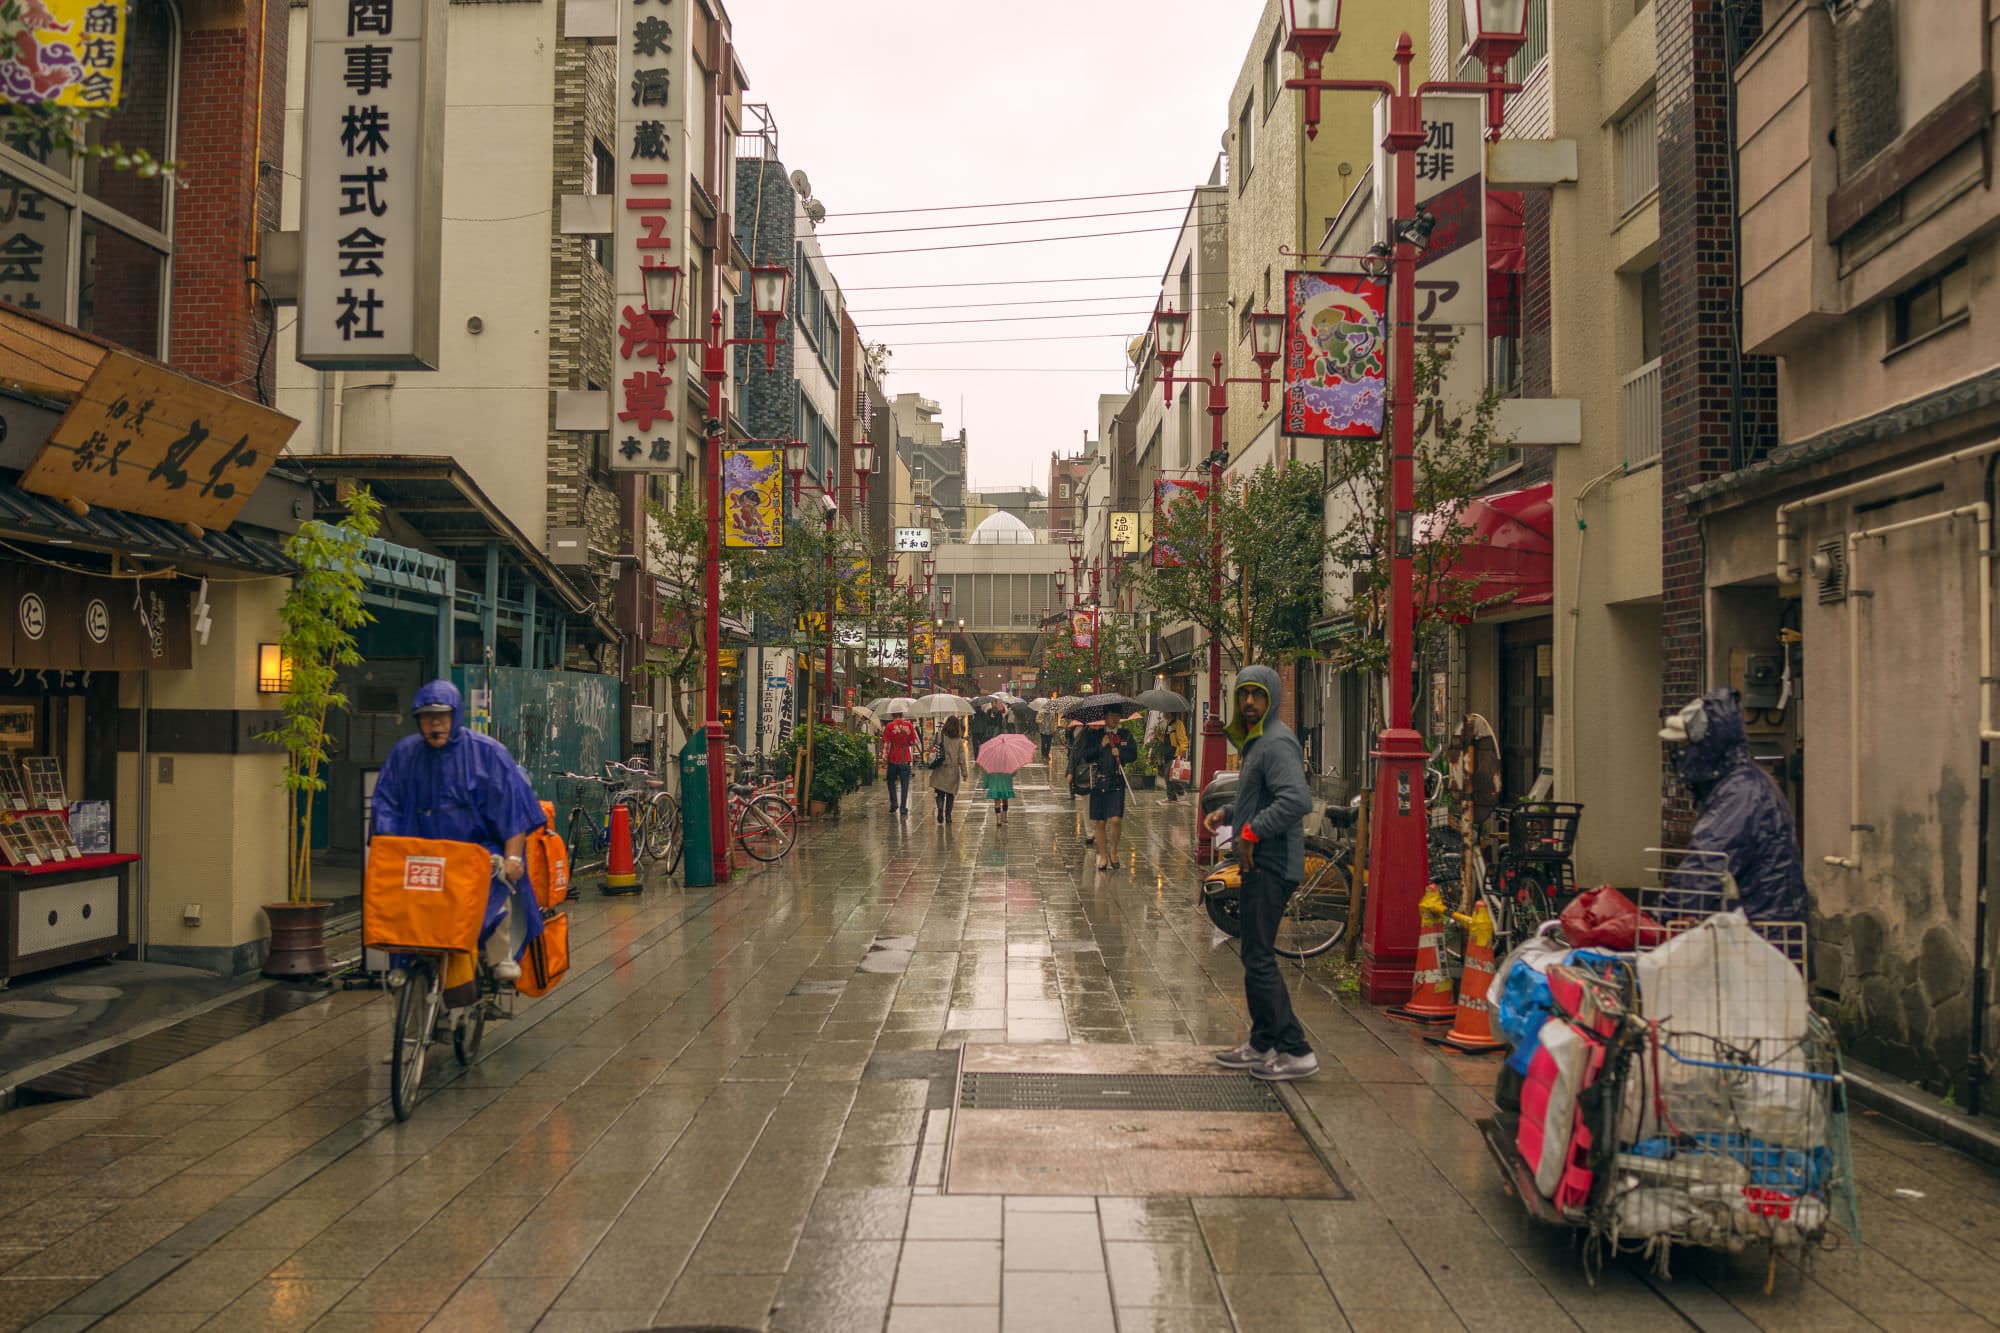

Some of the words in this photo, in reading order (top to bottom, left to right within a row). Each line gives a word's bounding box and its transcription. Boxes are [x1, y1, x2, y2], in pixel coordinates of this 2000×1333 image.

[82, 4, 118, 101] 商店会
[631, 0, 673, 161] 衆酒蔵
[335, 0, 394, 341] 商事株式会社
[618, 435, 672, 462] 本店
[898, 538, 929, 549] 十和田
